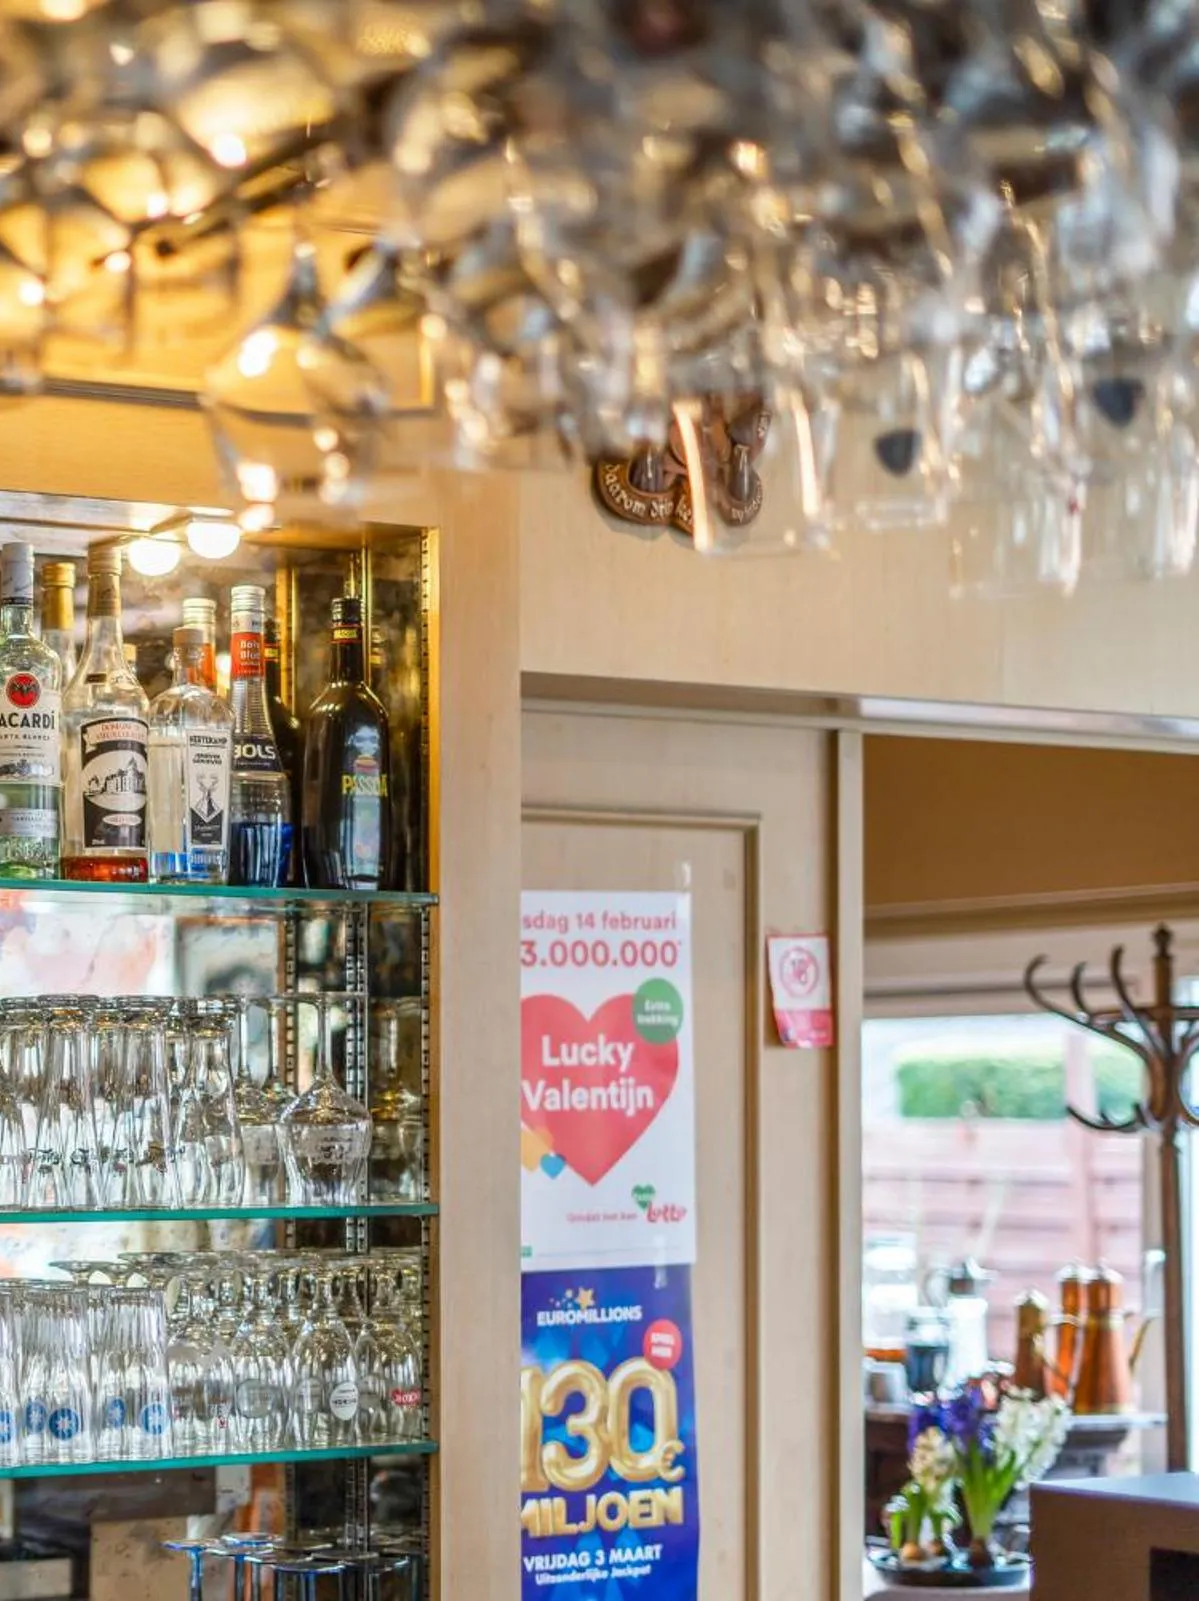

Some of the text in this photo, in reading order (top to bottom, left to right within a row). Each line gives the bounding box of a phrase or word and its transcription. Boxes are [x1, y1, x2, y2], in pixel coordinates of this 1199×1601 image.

[577, 912, 595, 930] 14
[602, 910, 676, 930] februari
[540, 1034, 635, 1071] Lucky
[521, 1077, 654, 1118] Valentijn
[536, 1305, 643, 1327] EUROMILLIONS
[523, 1543, 663, 1572] VRIJDAG 3 MAART
